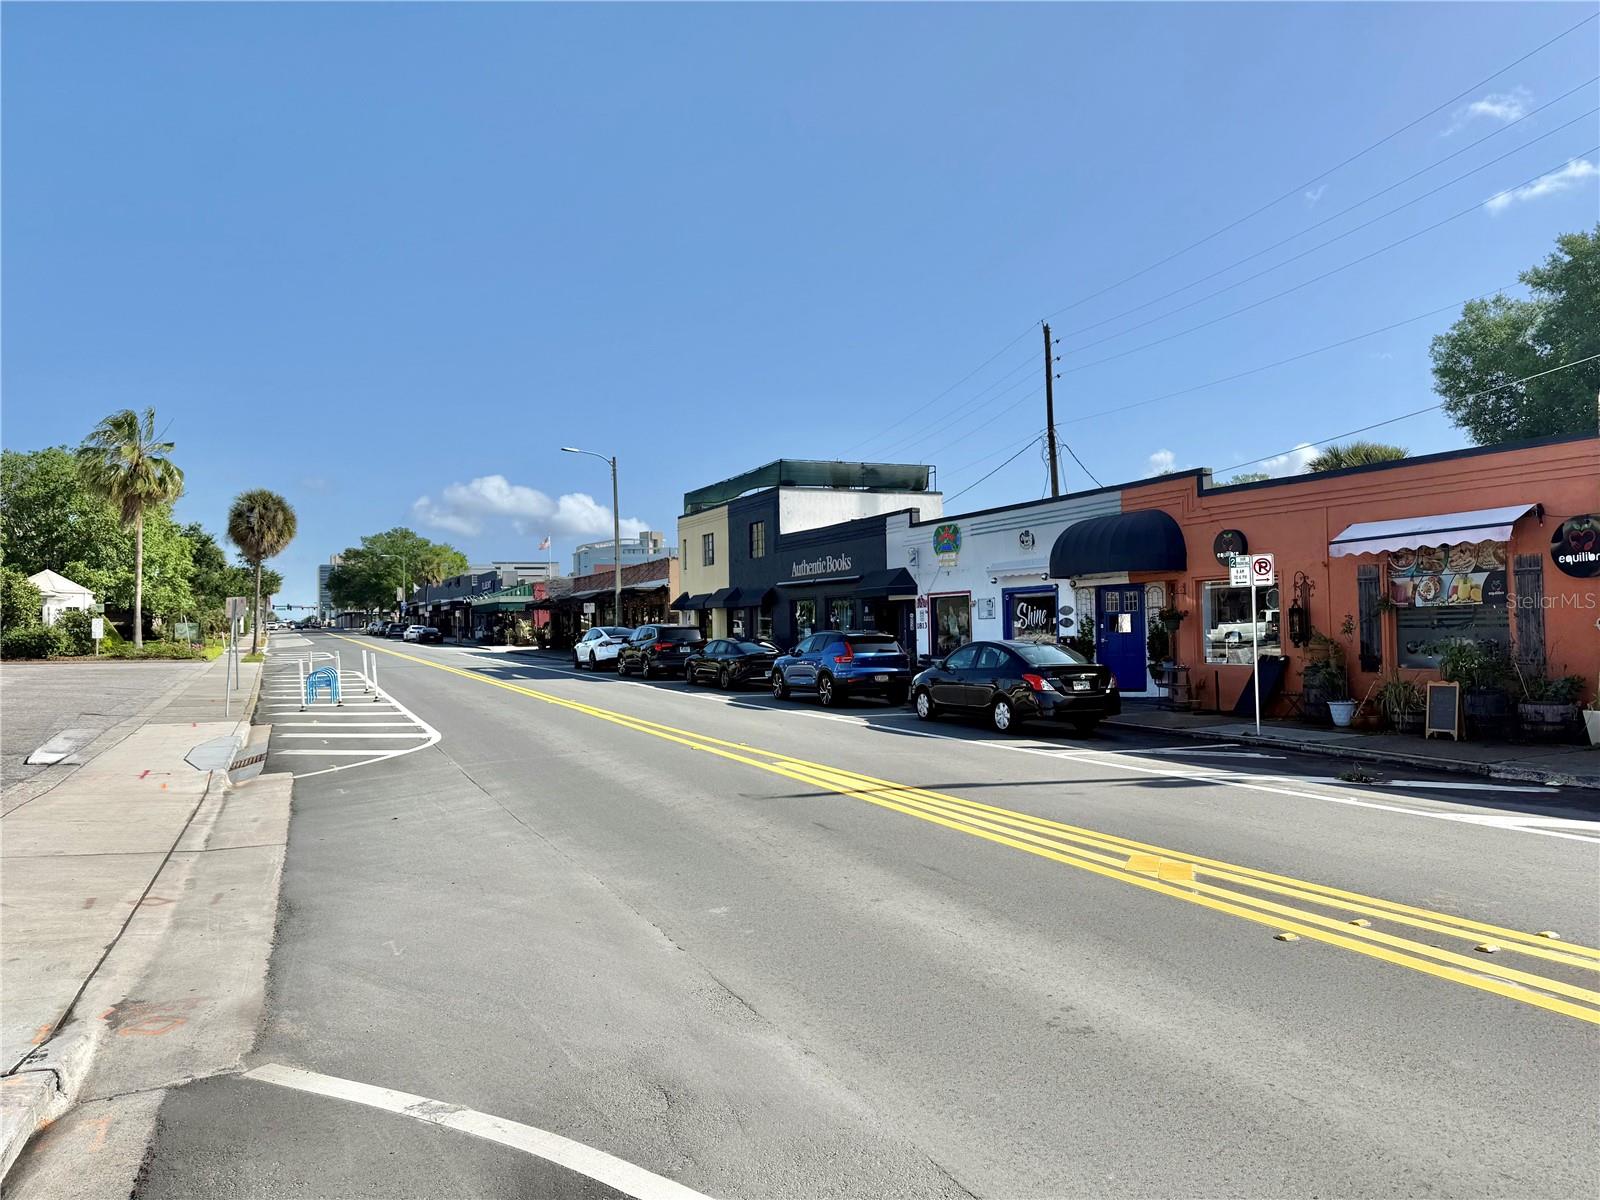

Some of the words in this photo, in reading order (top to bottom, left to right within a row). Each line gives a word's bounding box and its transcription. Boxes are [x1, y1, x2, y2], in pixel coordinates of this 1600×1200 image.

[791, 557, 827, 577] Authentic
[826, 553, 852, 573] Books
[1230, 558, 1236, 568] 2
[1016, 602, 1047, 629] Shine
